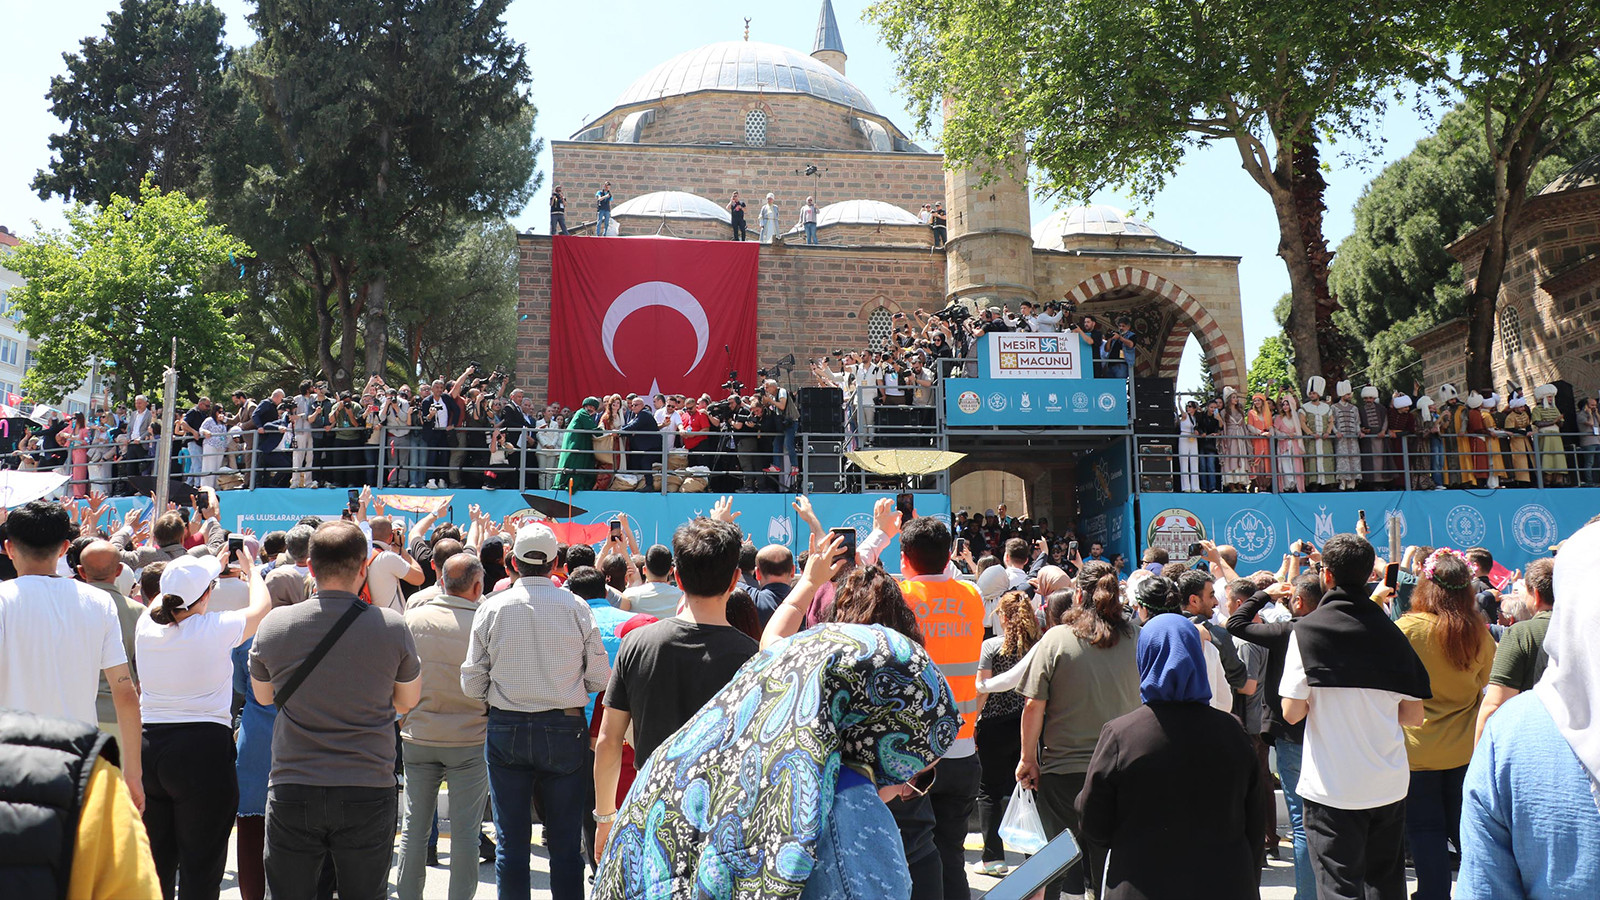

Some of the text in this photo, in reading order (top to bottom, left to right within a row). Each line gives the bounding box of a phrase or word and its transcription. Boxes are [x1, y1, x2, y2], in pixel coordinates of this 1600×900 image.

[1003, 339, 1036, 350] MESİR
[1020, 357, 1069, 366] MACUNU
[916, 598, 967, 619] ÖZEL
[917, 619, 973, 638] ÜVENLİK
